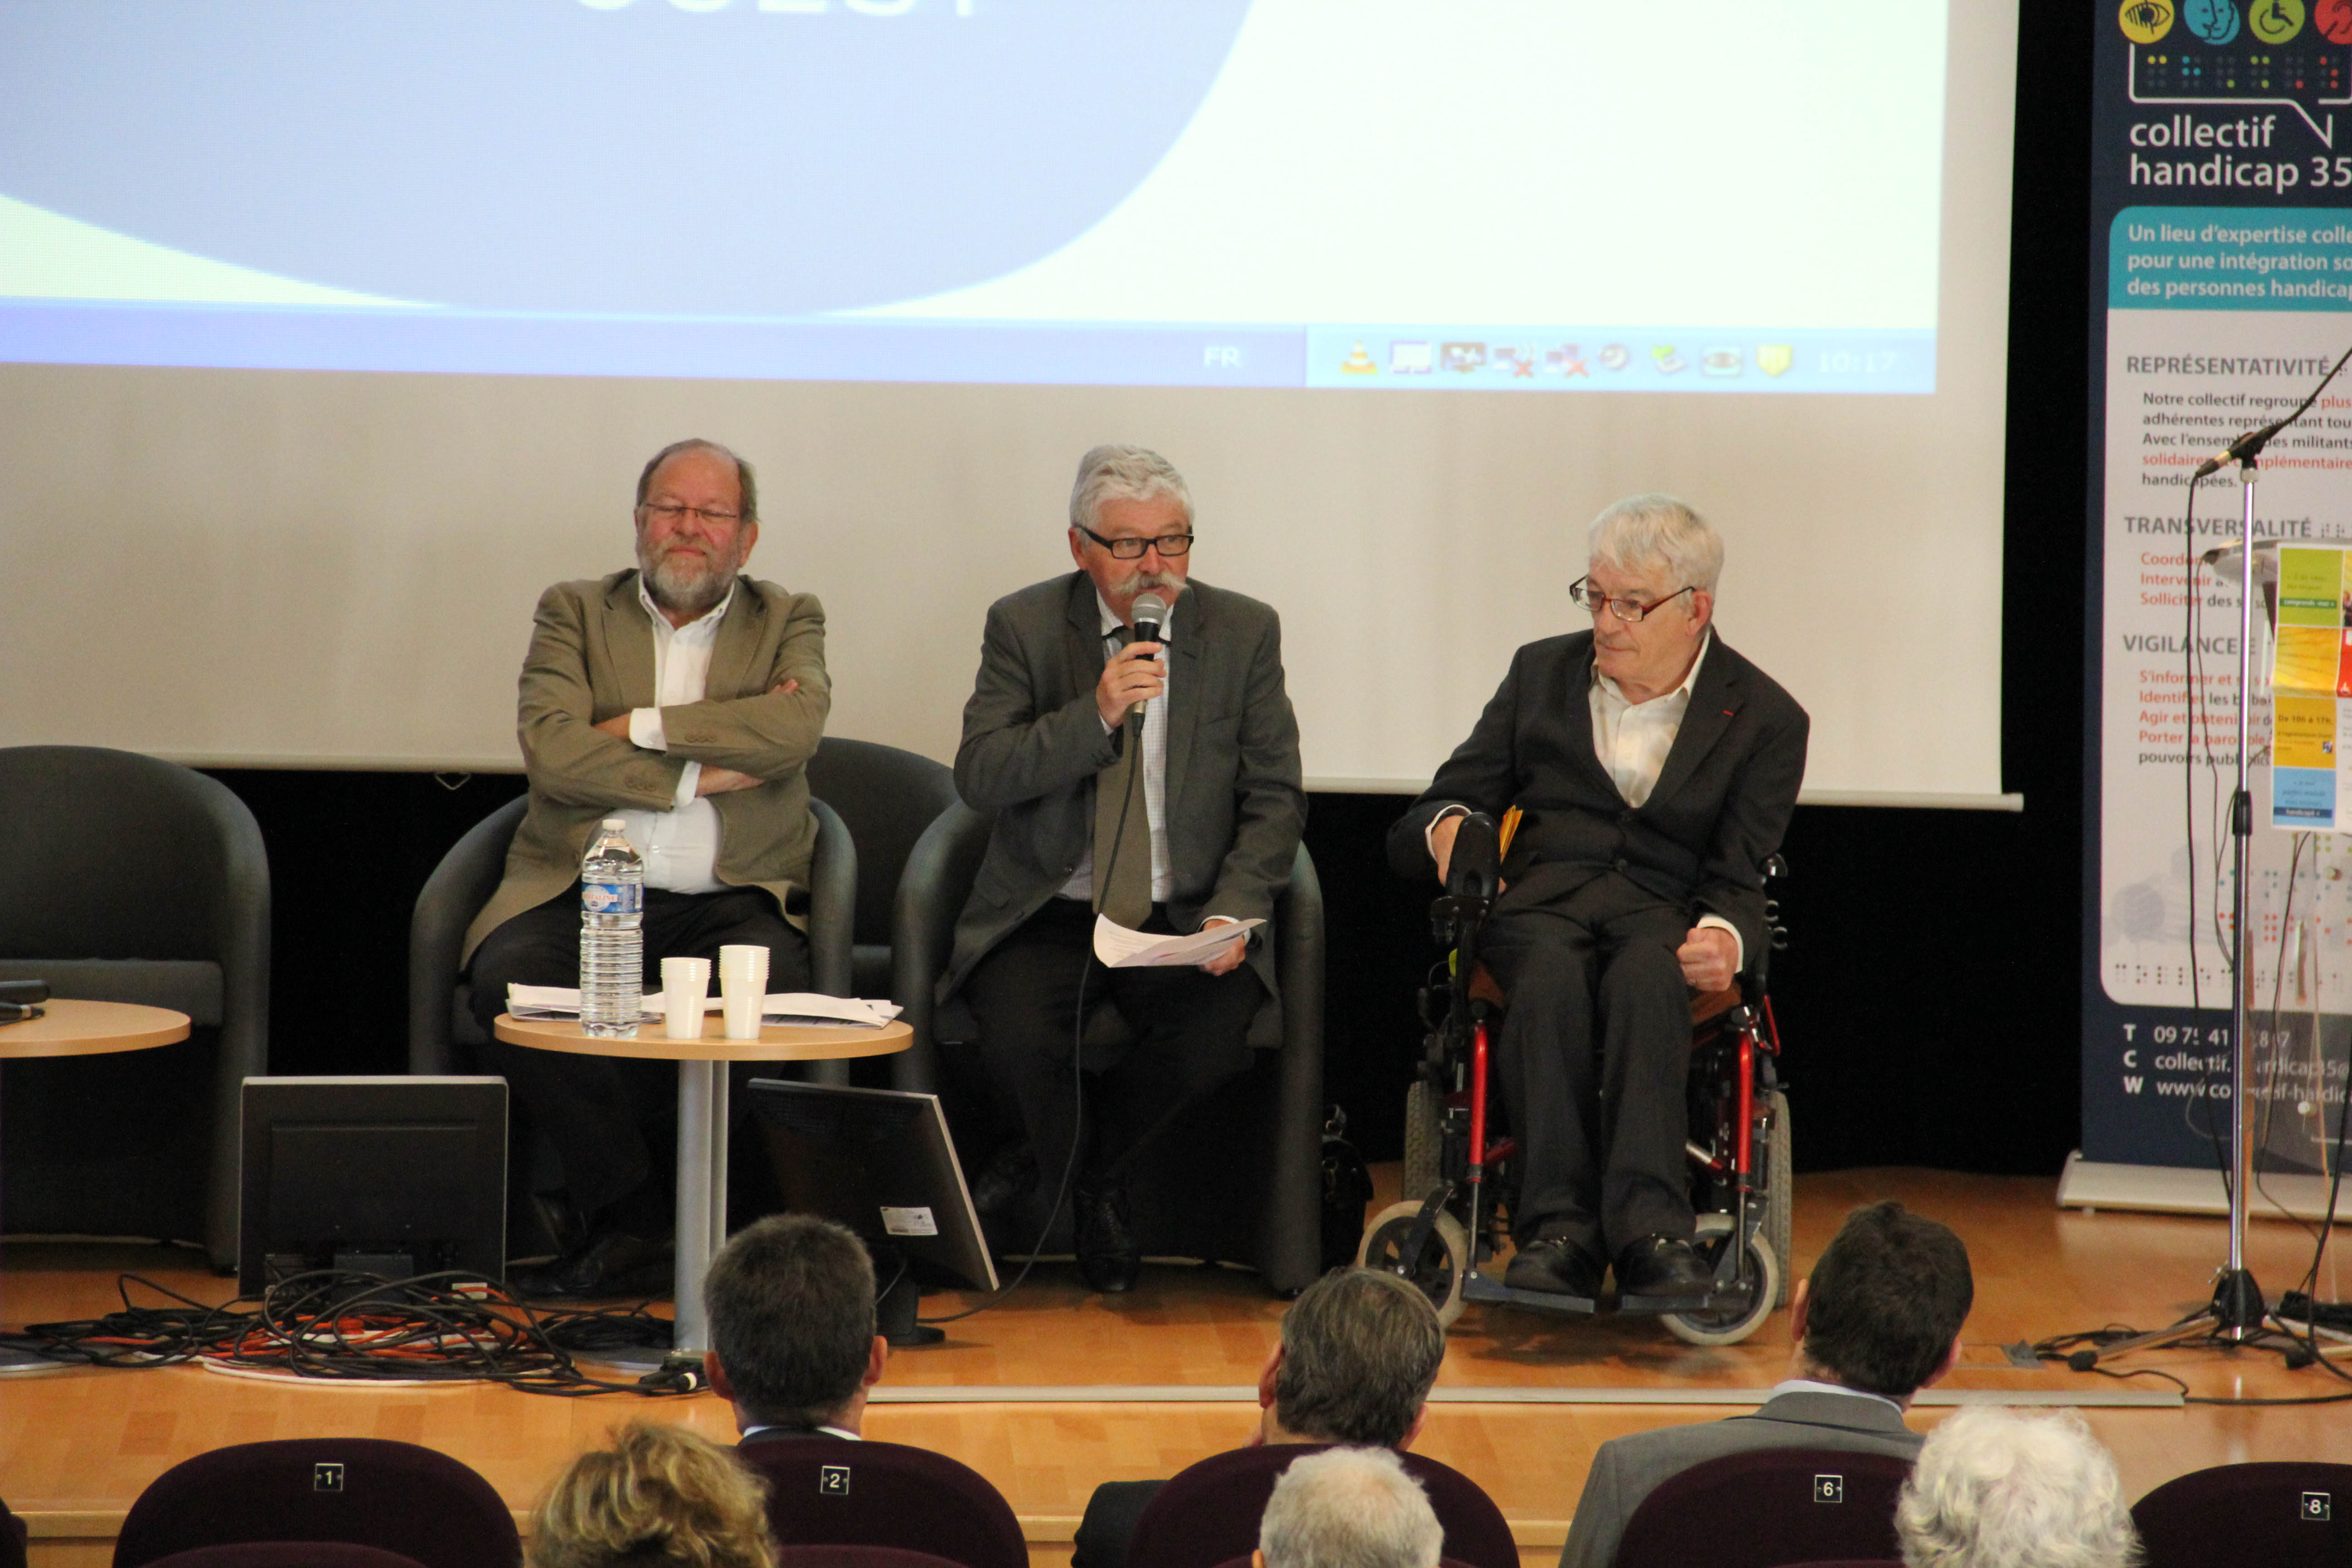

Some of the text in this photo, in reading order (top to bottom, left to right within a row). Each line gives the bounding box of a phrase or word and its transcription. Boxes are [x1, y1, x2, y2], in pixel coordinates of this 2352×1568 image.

[2130, 114, 2276, 147] collectif
[2130, 153, 2352, 195] handicap 35
[2129, 224, 2155, 242] Un
[2161, 223, 2195, 242] lieu
[2200, 223, 2307, 247] d'expertise
[2128, 255, 2174, 273] pour
[2179, 255, 2215, 269] une
[2220, 252, 2328, 274] intégration
[2127, 276, 2352, 302] des personnes handica
[1204, 347, 1241, 368] FR
[2127, 353, 2330, 376] REPRÉSENTATIVITÉ
[2144, 392, 2183, 405] Notre
[2188, 392, 2245, 406] collectif
[2322, 395, 2352, 411] plus
[2143, 412, 2225, 426] adhérentes
[2328, 416, 2352, 428] tou
[2143, 432, 2177, 445] Avec
[2181, 432, 2242, 446] l'ensem
[2142, 452, 2210, 466] solidaire
[2234, 455, 2352, 470] cplémentaire
[2207, 594, 2232, 607] des
[2123, 634, 2237, 655] VIGILANCE
[2218, 674, 2231, 686] et
[2140, 691, 2204, 705] Identife
[2209, 692, 2229, 705] les
[2139, 710, 2169, 726] Agir
[2173, 713, 2187, 725] et
[2139, 730, 2183, 744] Porter
[2138, 753, 2201, 765] pouvors
[2123, 1023, 2137, 1042] T
[2154, 1025, 2177, 1044] 09
[2208, 1028, 2229, 1046] 41
[2123, 1049, 2137, 1068] C
[2123, 1076, 2144, 1095] W
[325, 1470, 332, 1485] 1
[830, 1473, 840, 1488] 2
[1823, 1481, 1834, 1496] 6
[2309, 1499, 2321, 1514] 8
